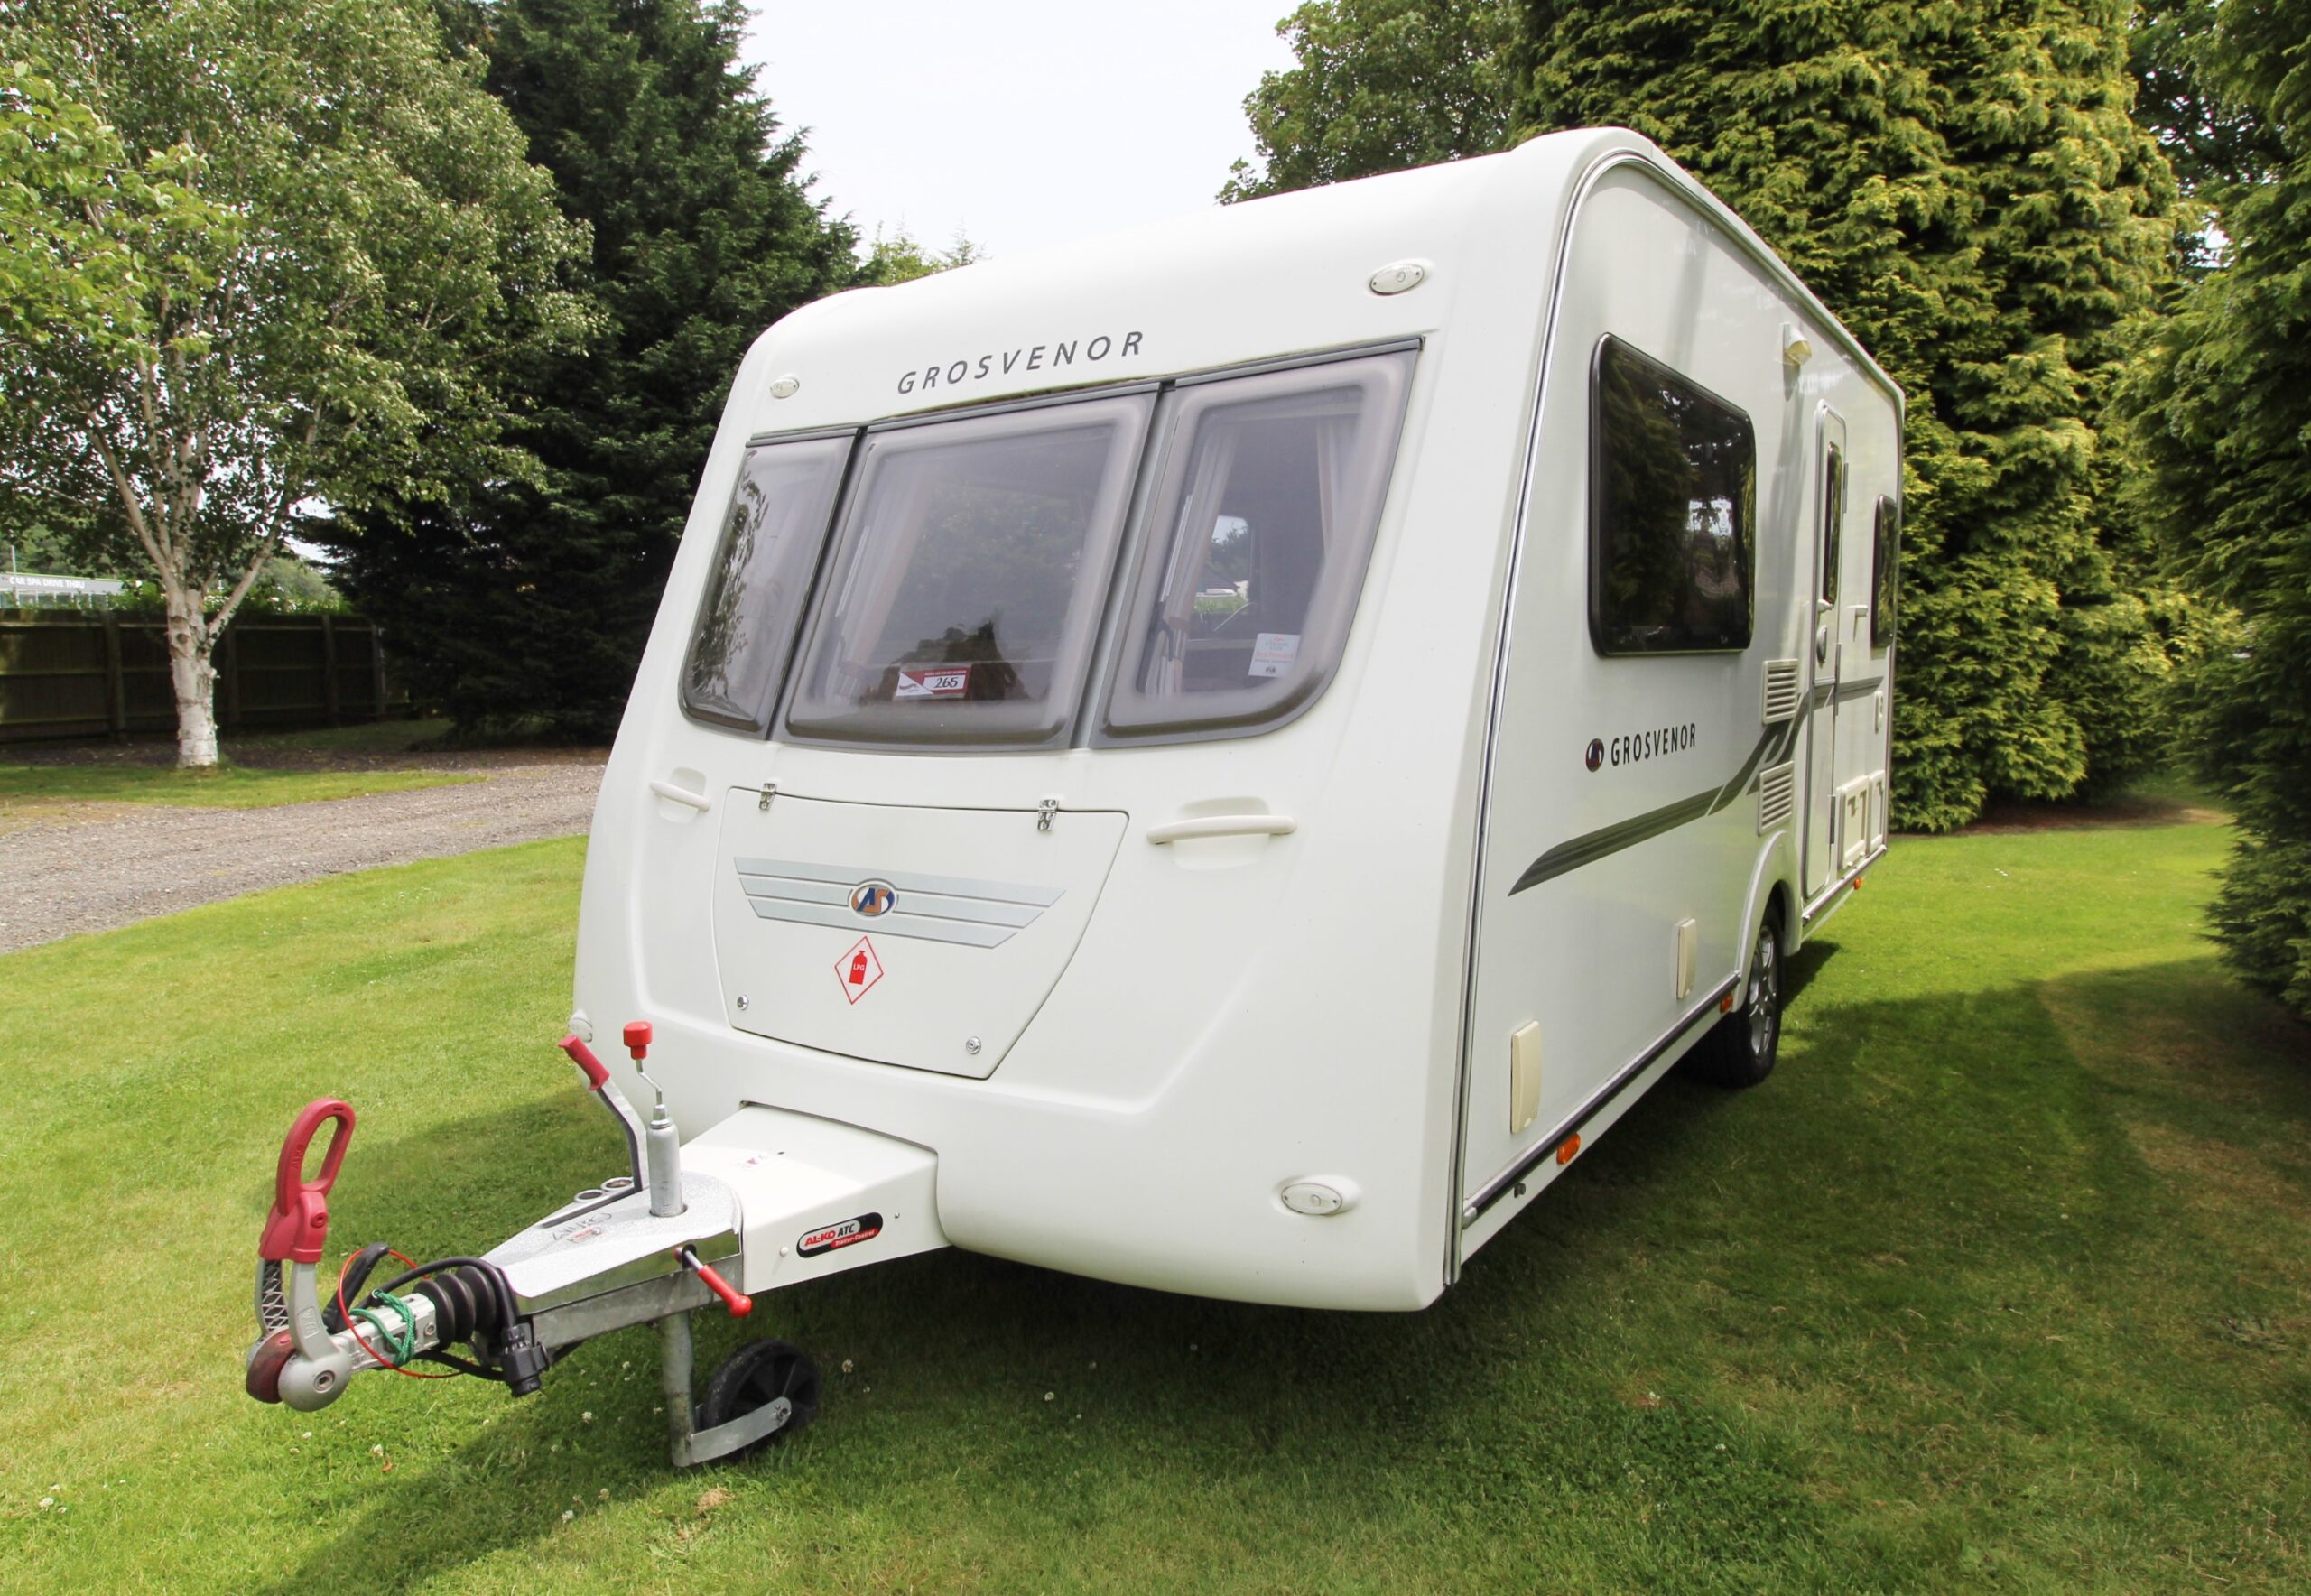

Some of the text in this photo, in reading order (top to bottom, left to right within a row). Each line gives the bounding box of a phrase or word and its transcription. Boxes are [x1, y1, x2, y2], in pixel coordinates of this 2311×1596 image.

[897, 330, 1144, 394] GROSVENOR
[10, 577, 85, 589] CAR SPA DRIVE THRU
[933, 677, 958, 688] 265
[1610, 722, 1696, 767] GROSVENOR
[804, 1223, 856, 1247] AL-KO ATC
